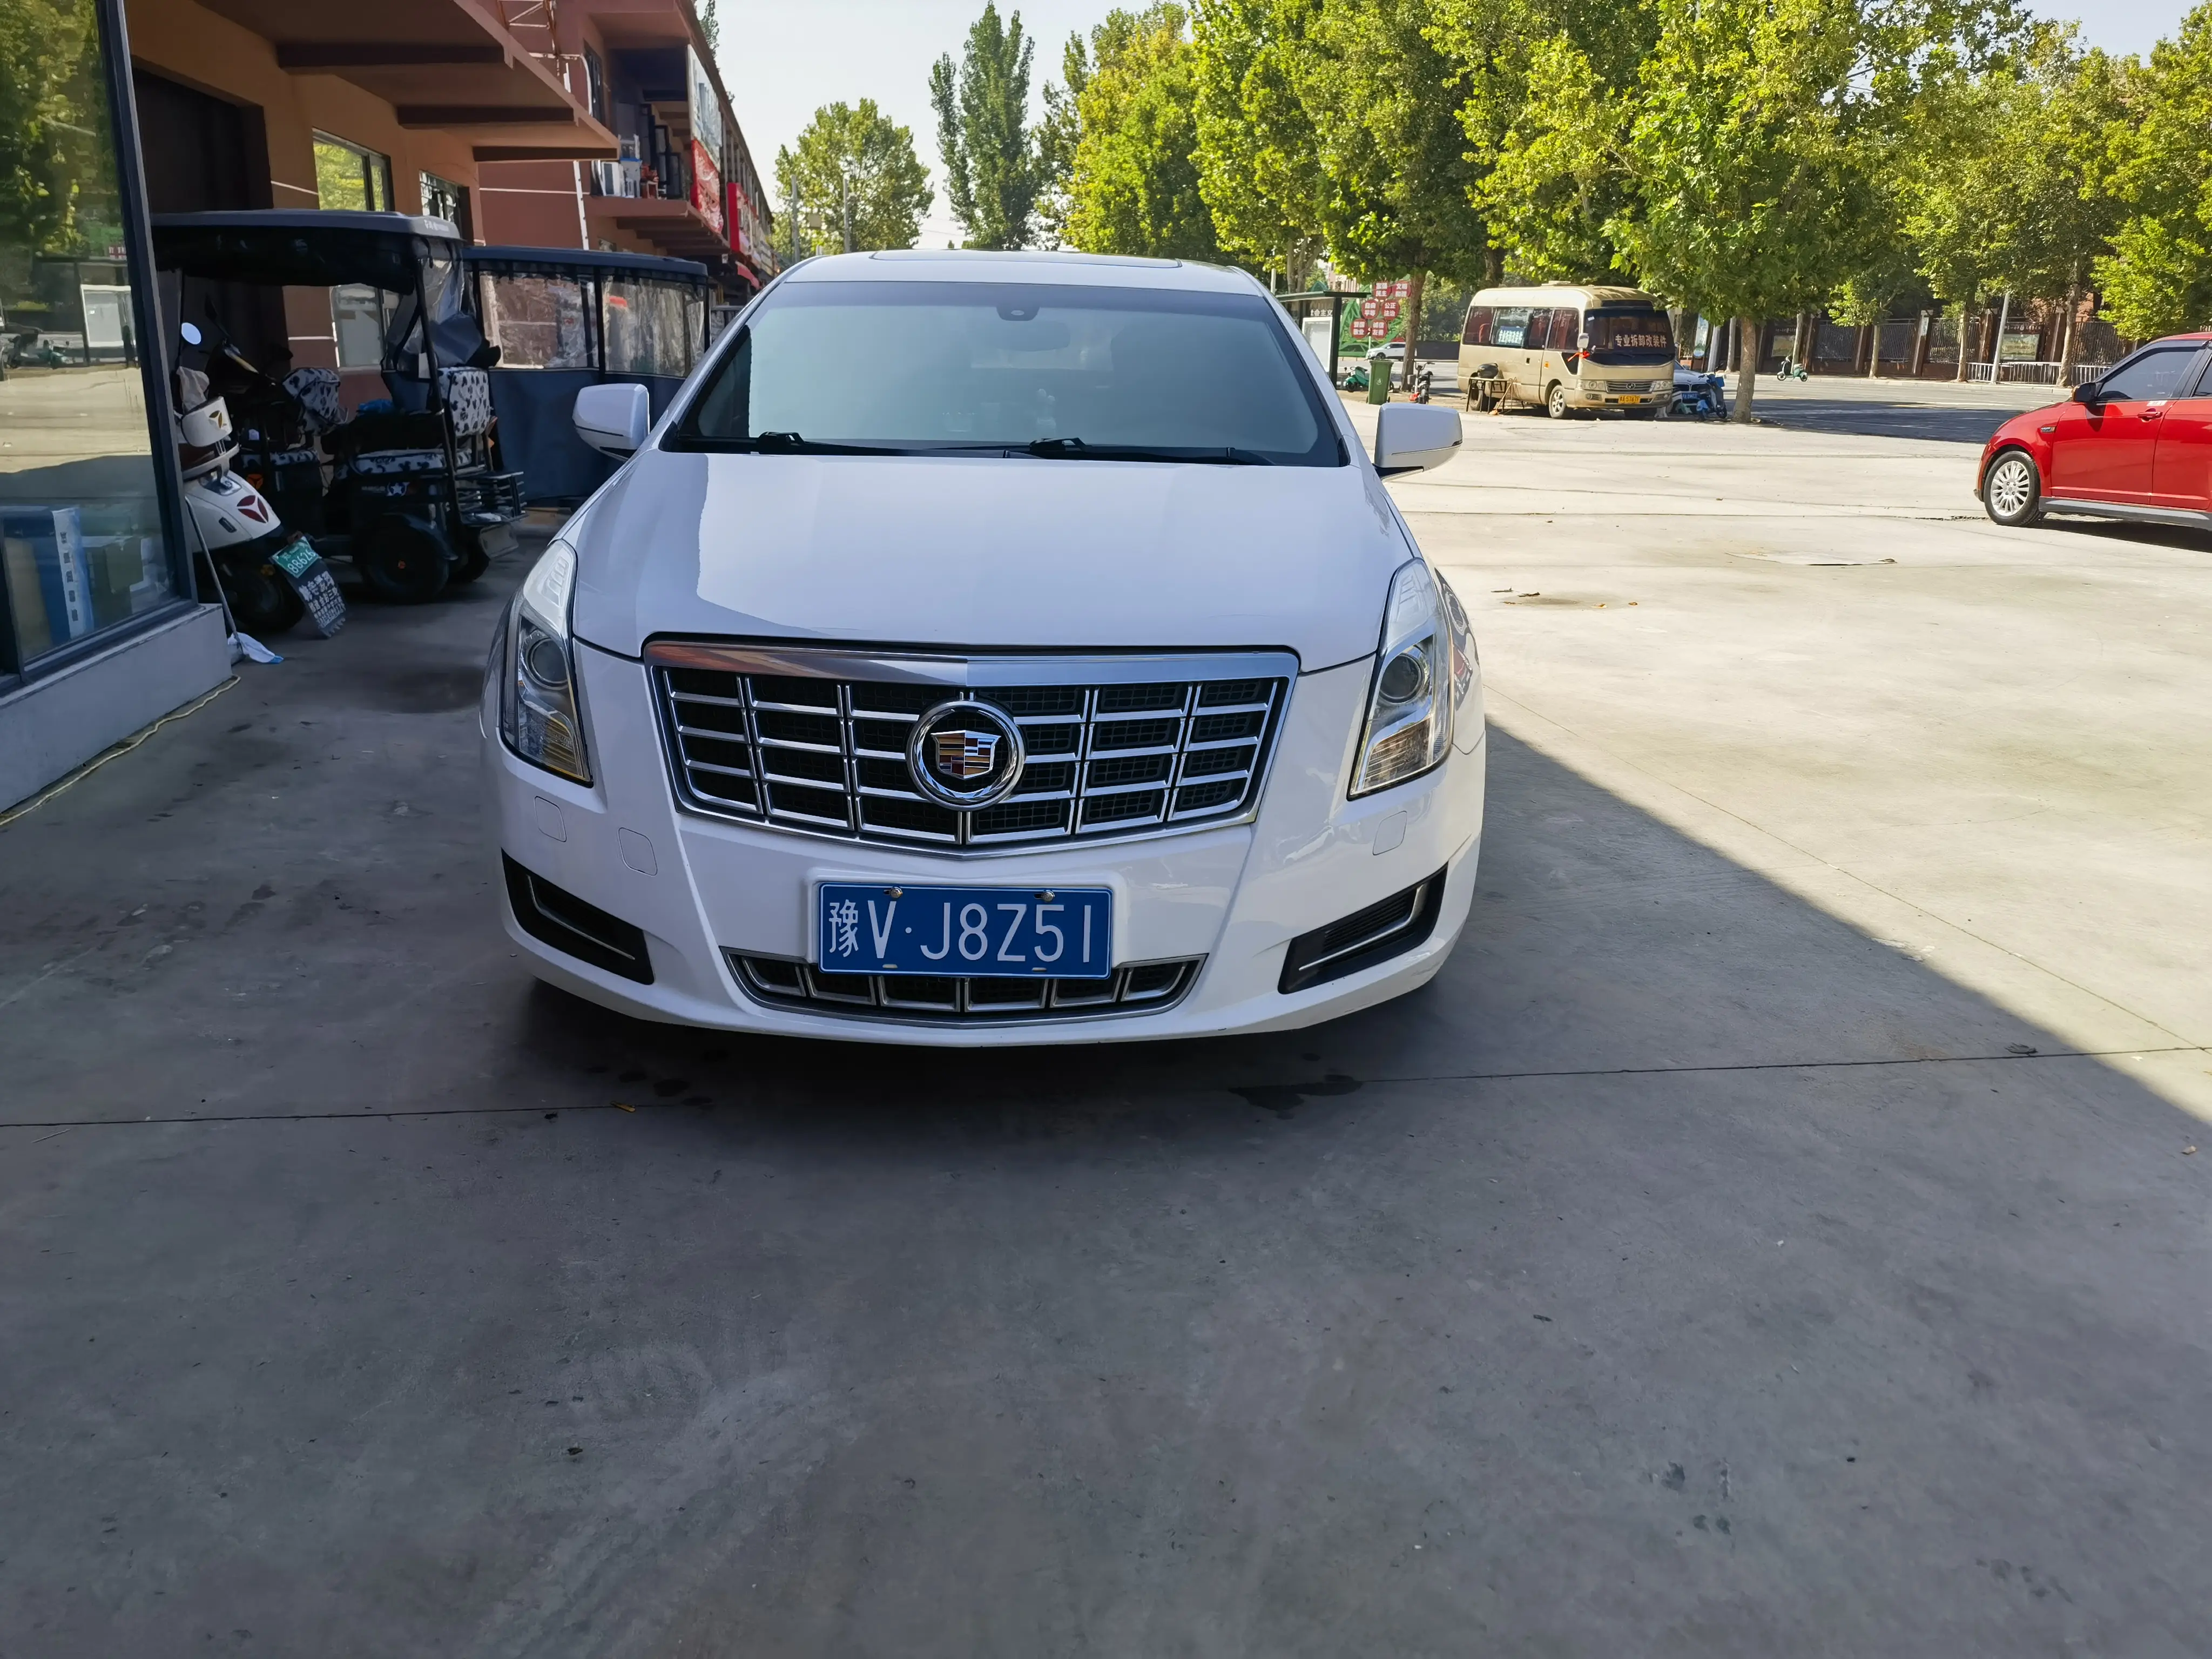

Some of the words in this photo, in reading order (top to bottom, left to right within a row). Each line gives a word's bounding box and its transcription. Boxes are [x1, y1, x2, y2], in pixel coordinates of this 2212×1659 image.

[1615, 334, 1667, 348] 专业拆卸改装件
[287, 548, 316, 574] 88626
